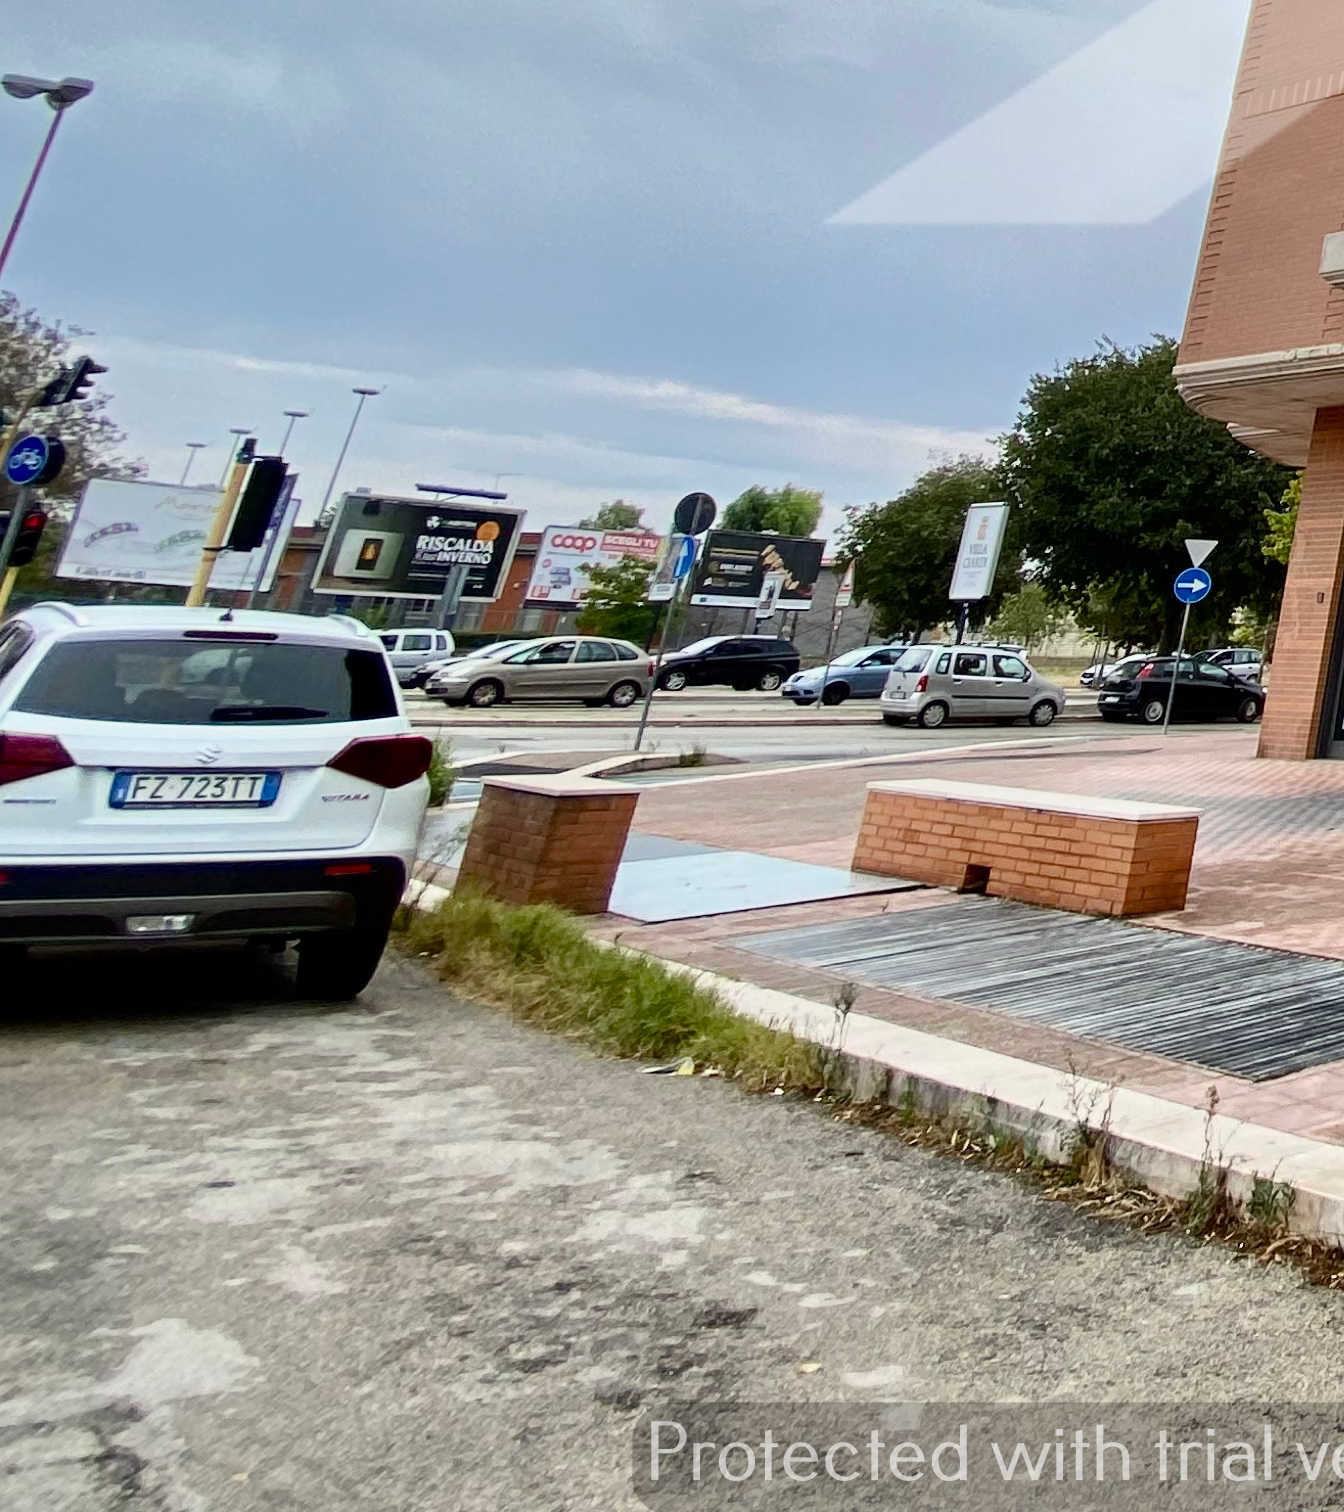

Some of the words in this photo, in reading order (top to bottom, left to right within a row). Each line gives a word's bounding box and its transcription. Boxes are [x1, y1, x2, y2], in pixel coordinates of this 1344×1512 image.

[416, 534, 494, 554] RISCALDA
[551, 534, 597, 553] coop
[436, 550, 492, 565] INVERNO
[131, 775, 164, 800] FZ
[173, 774, 264, 800] 723TT
